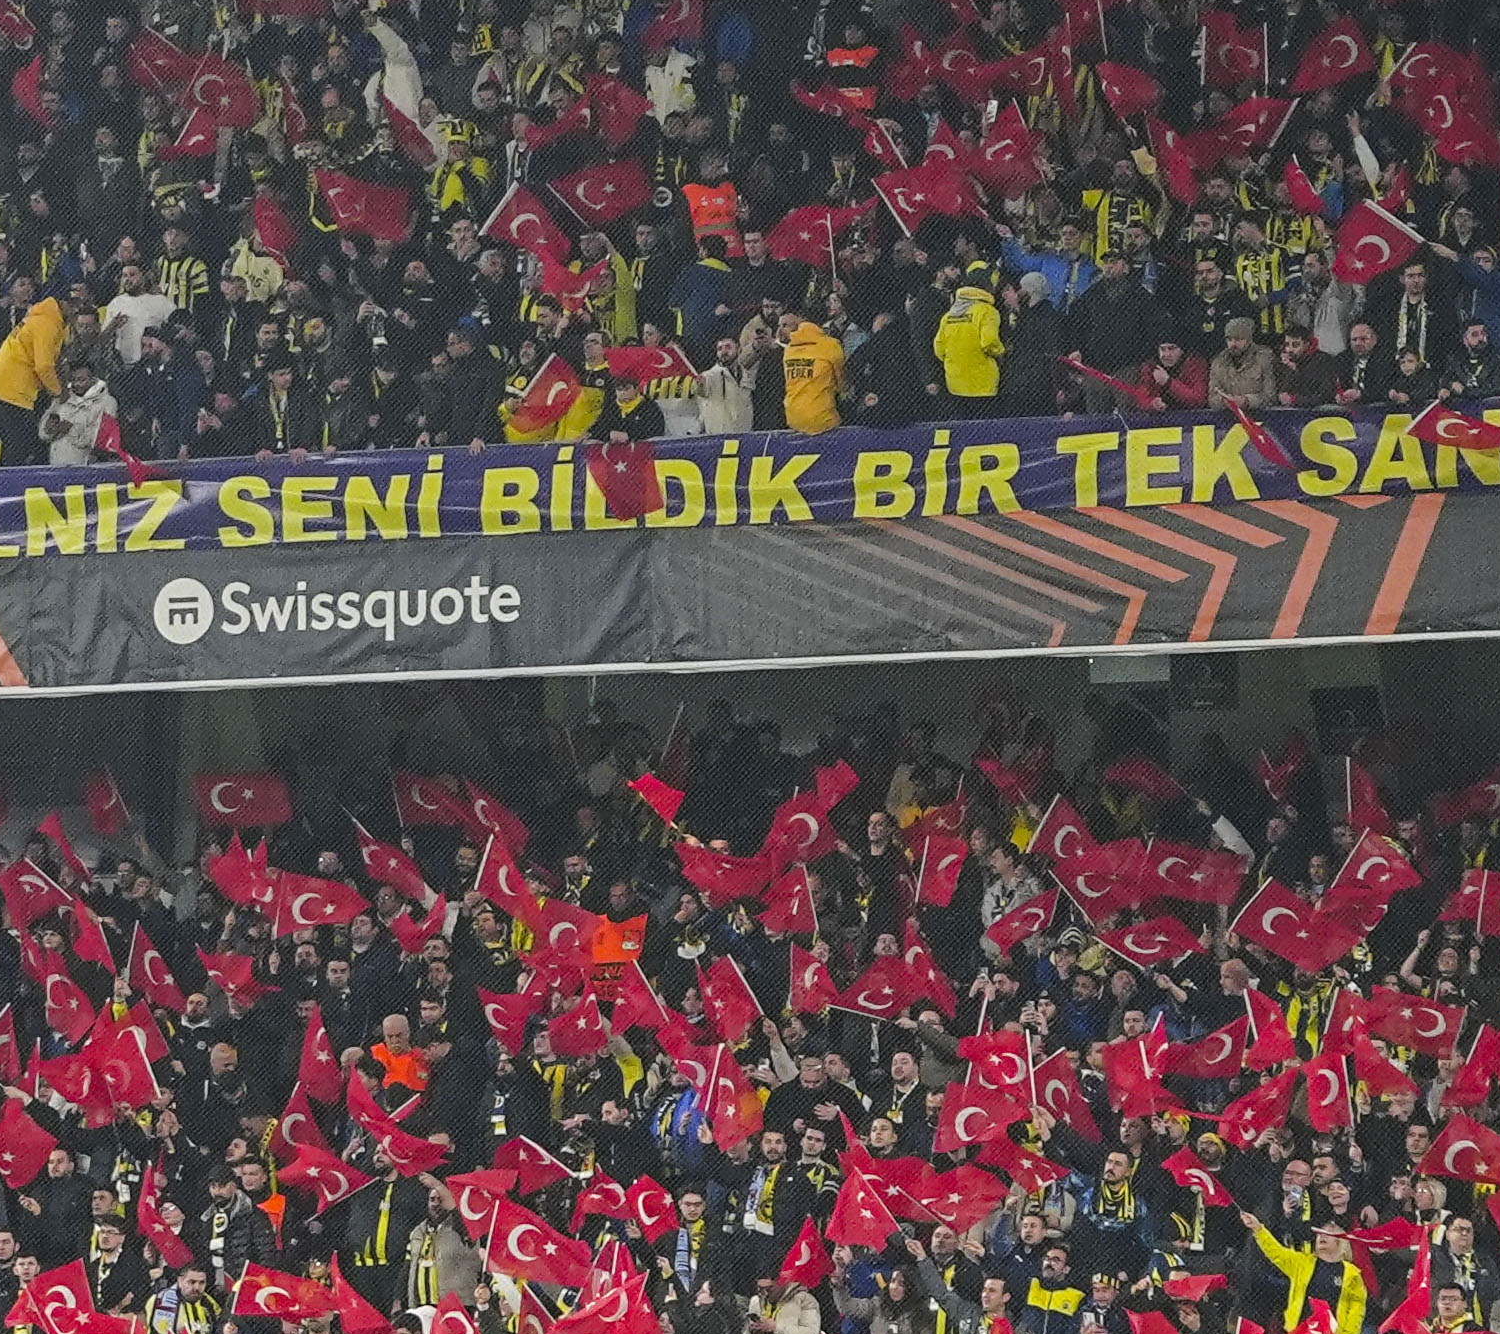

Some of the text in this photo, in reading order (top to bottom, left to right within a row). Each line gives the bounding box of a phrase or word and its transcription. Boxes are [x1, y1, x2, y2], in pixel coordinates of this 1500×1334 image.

[218, 454, 444, 548] SENİ
[852, 429, 1025, 519] BİR
[1055, 421, 1264, 507] TEK
[220, 575, 522, 642] Swissquote
